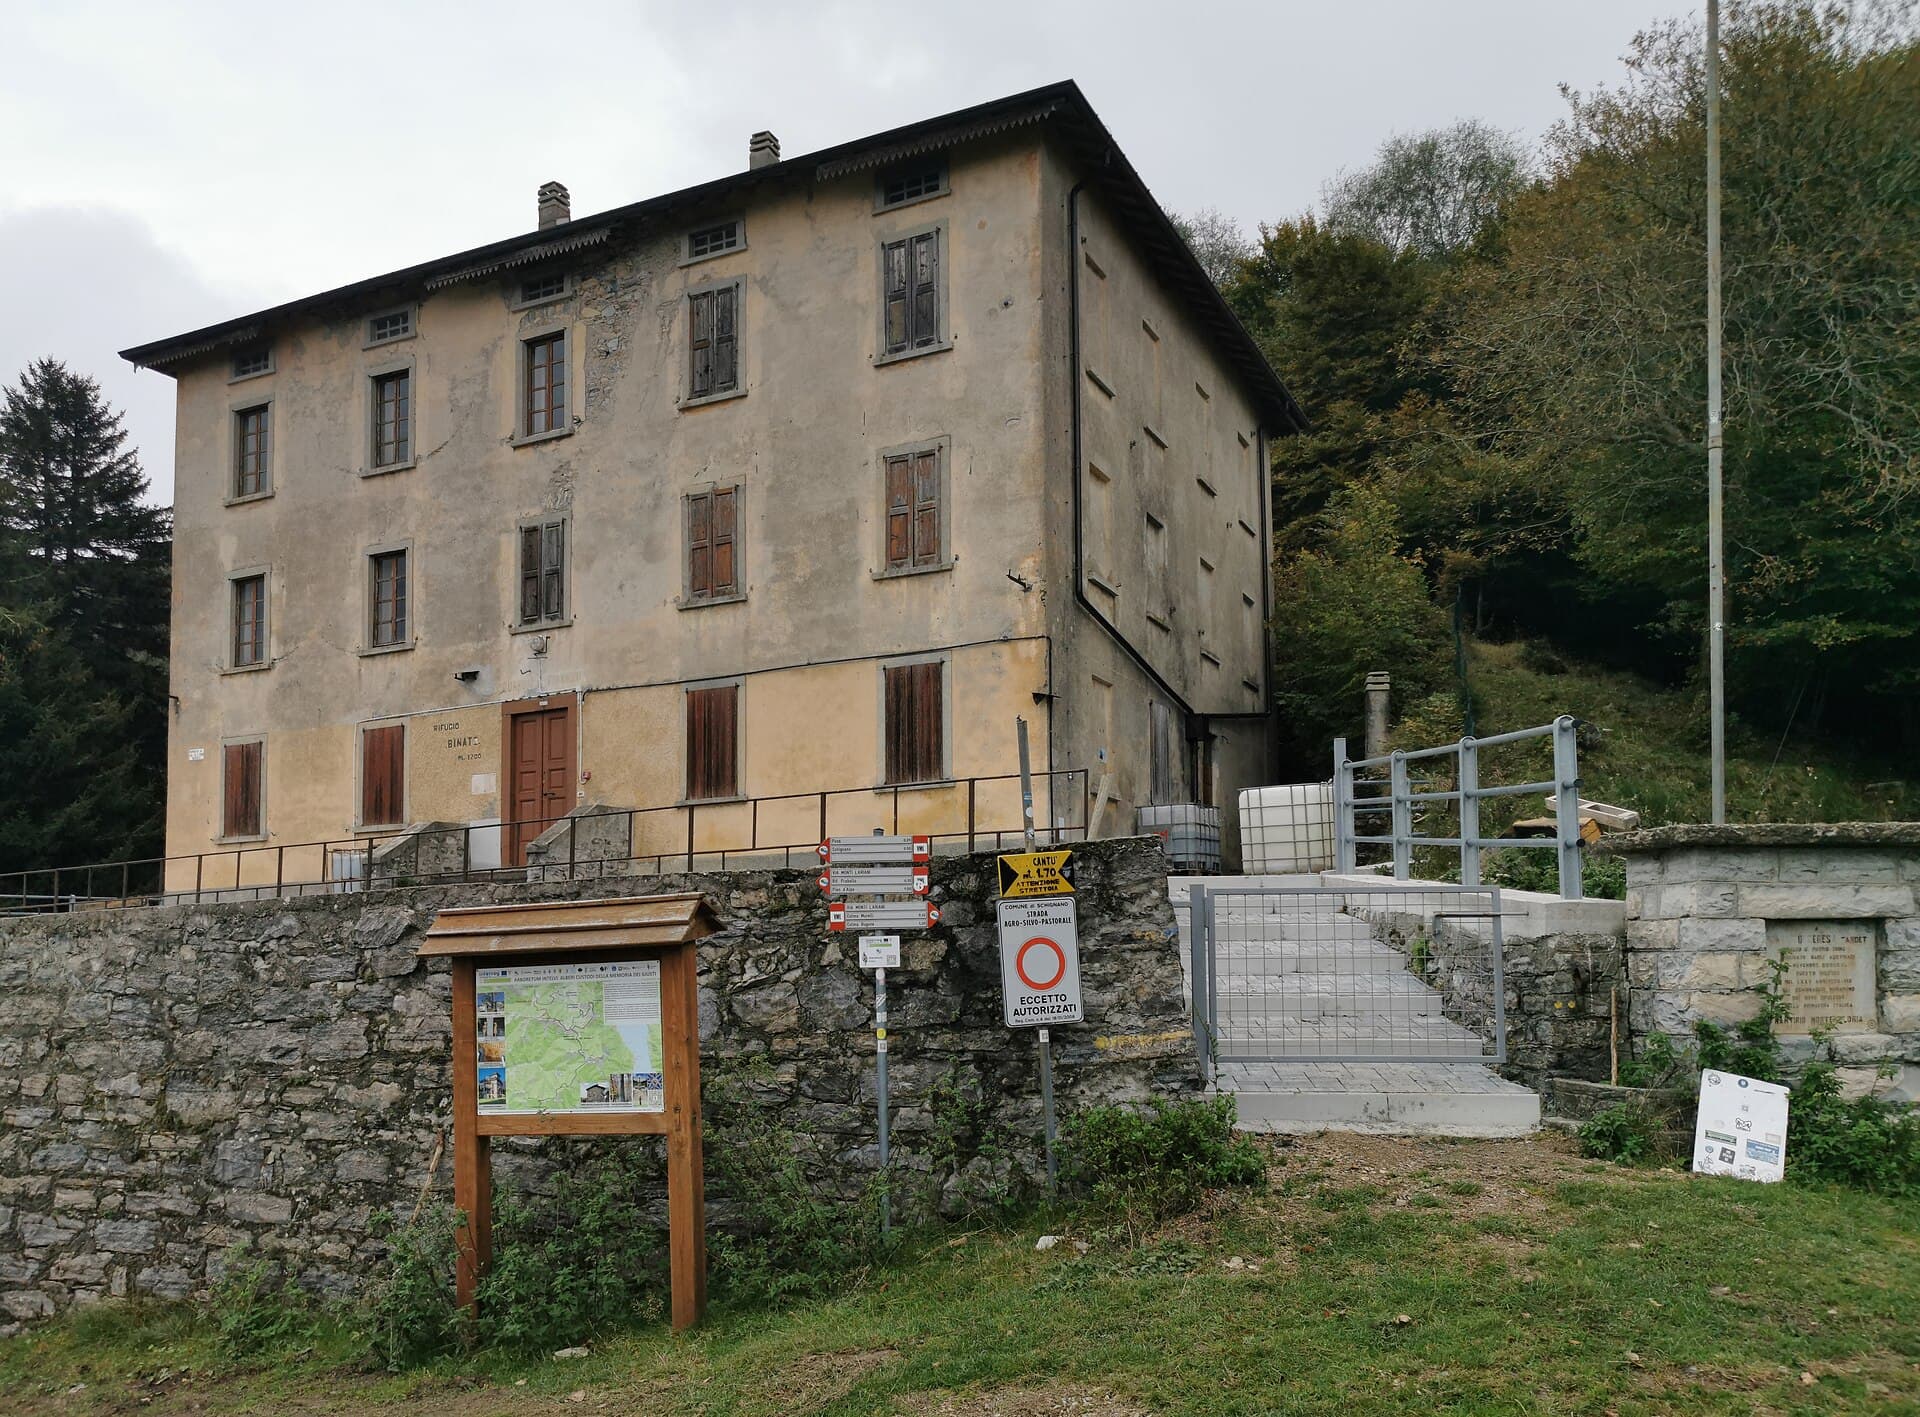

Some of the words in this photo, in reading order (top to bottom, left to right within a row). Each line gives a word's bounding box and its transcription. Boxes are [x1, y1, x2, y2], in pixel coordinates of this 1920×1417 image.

[1016, 878, 1060, 888] ATTENZIONE
[1037, 901, 1069, 909] SCHIGNANO
[1026, 910, 1049, 918] STRADA
[1004, 916, 1073, 928] AGRO-SILVO-PASTORALE
[1020, 993, 1067, 1005] ECCETTO
[1013, 1003, 1077, 1017] AUTORIZZATI
